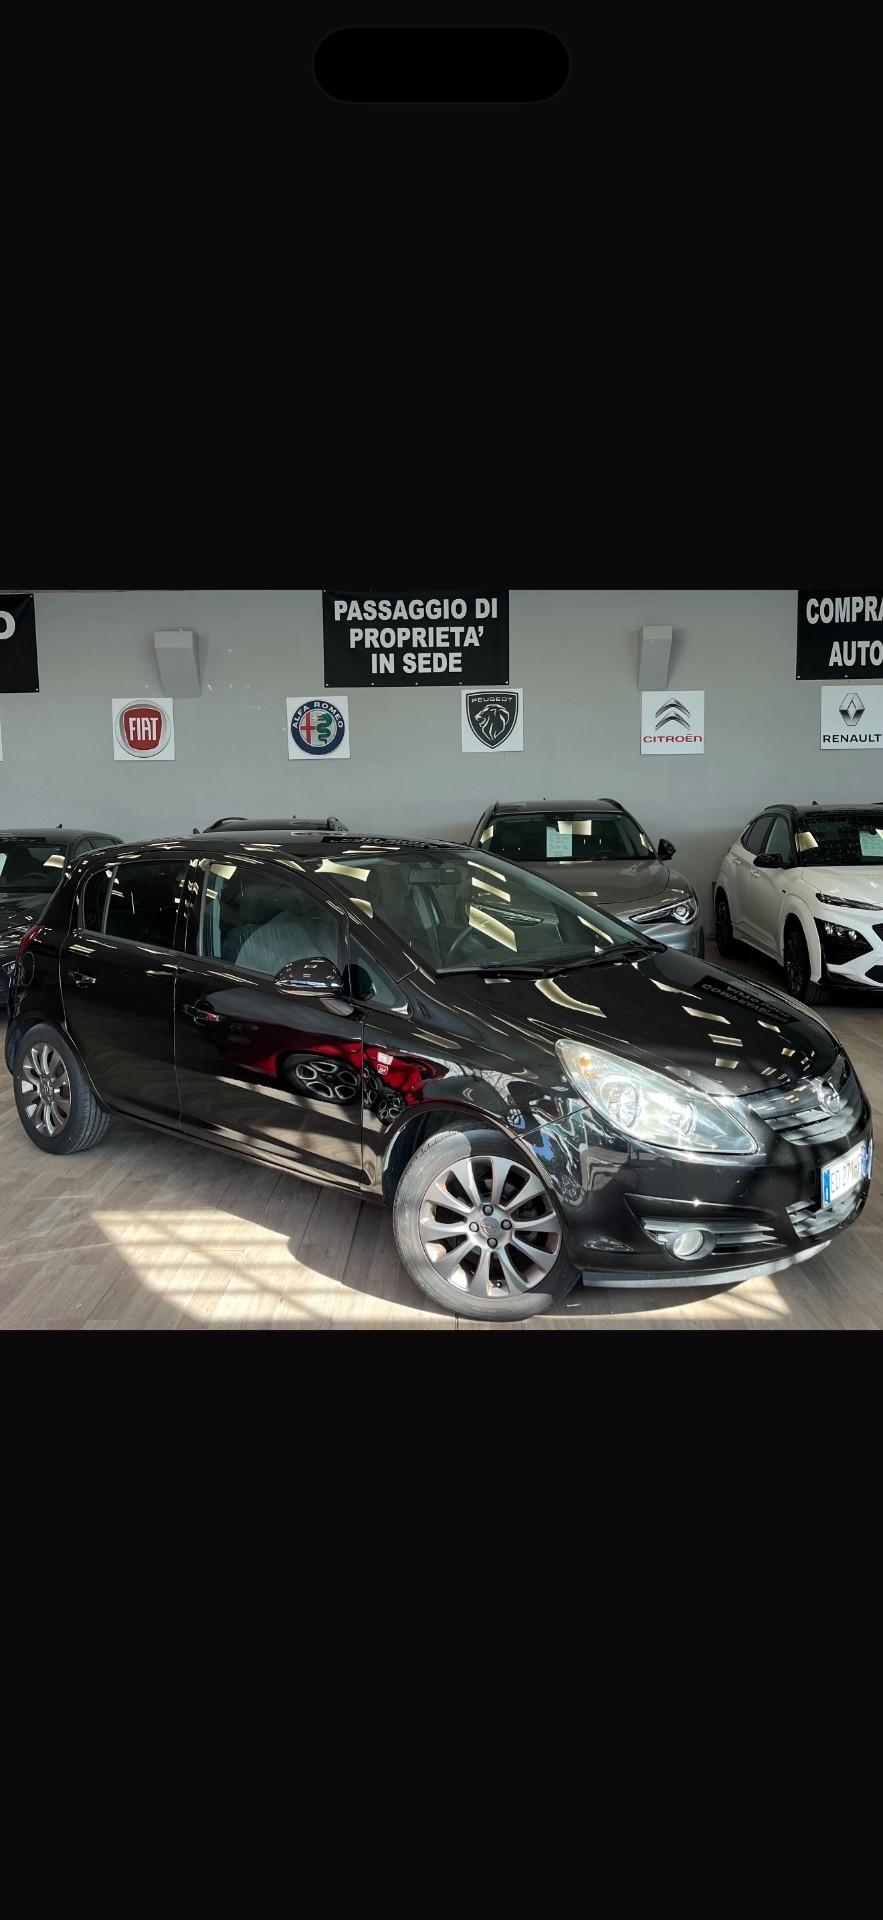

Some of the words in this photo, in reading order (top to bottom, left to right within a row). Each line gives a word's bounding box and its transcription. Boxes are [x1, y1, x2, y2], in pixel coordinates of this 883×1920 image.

[334, 598, 467, 621] PASSAGGIO
[475, 598, 498, 619] DI
[371, 653, 395, 674] IN
[402, 652, 463, 674] SEDE
[828, 640, 883, 667] AUTO
[292, 705, 310, 729] ALFA
[313, 701, 344, 728] ROMEO
[128, 717, 159, 741] FIAT
[822, 734, 882, 743] RENAULT
